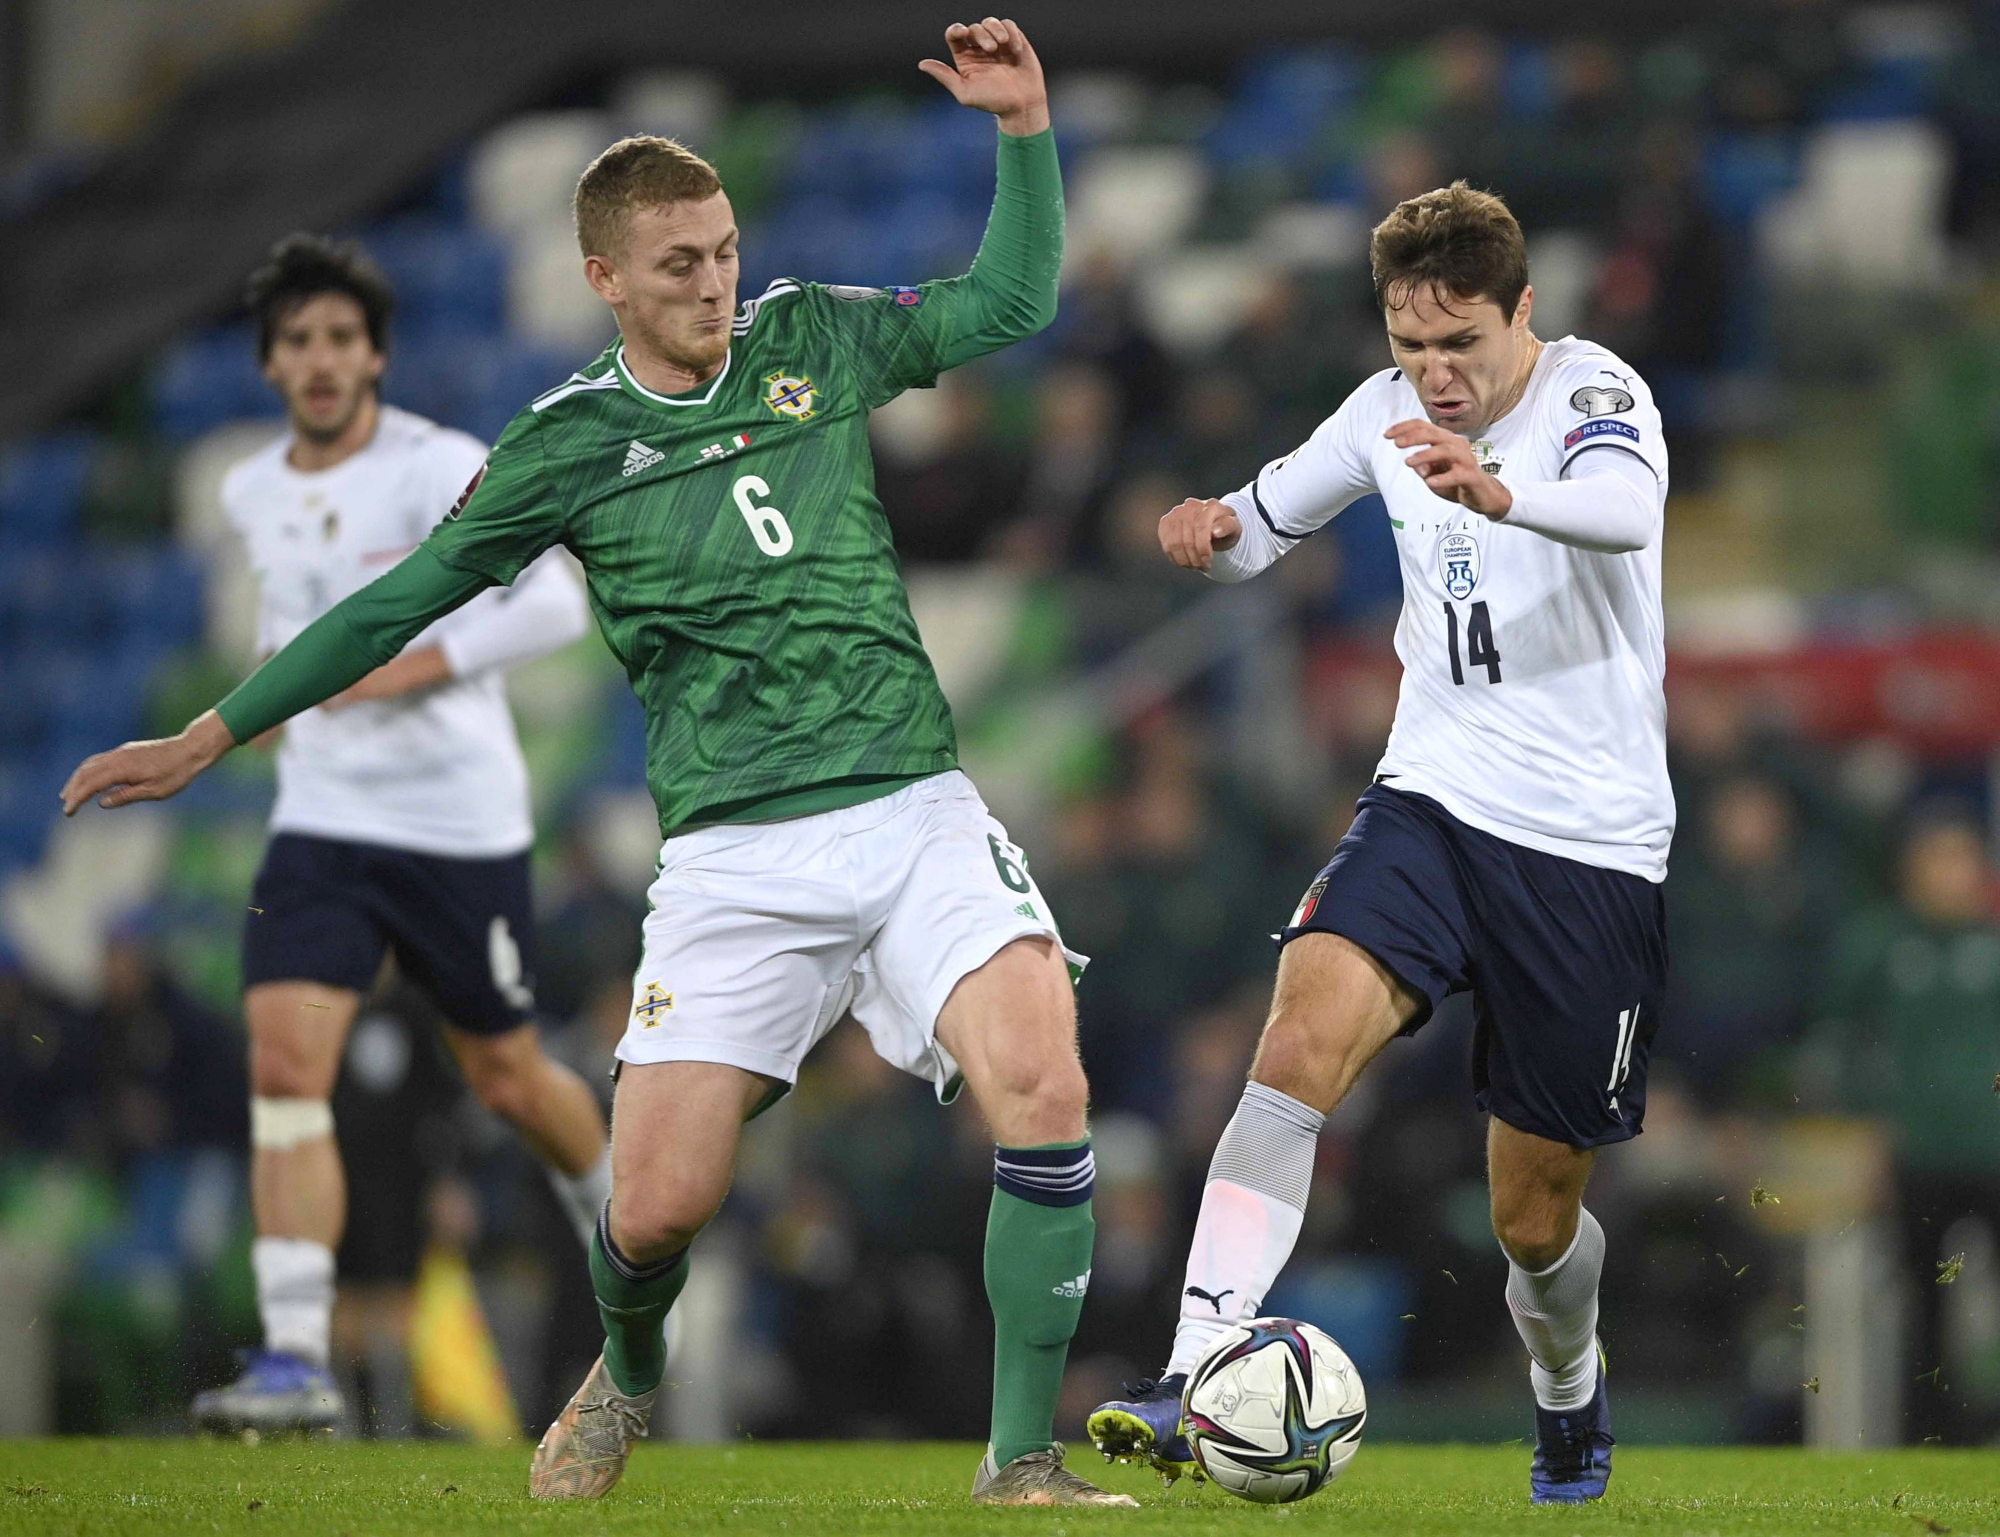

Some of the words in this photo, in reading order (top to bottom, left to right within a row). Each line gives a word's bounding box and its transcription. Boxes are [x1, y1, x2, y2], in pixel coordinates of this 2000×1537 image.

[1583, 423, 1639, 438] RESPECT
[622, 451, 665, 477] adidas
[733, 475, 794, 557] 6
[1443, 600, 1502, 686] 14
